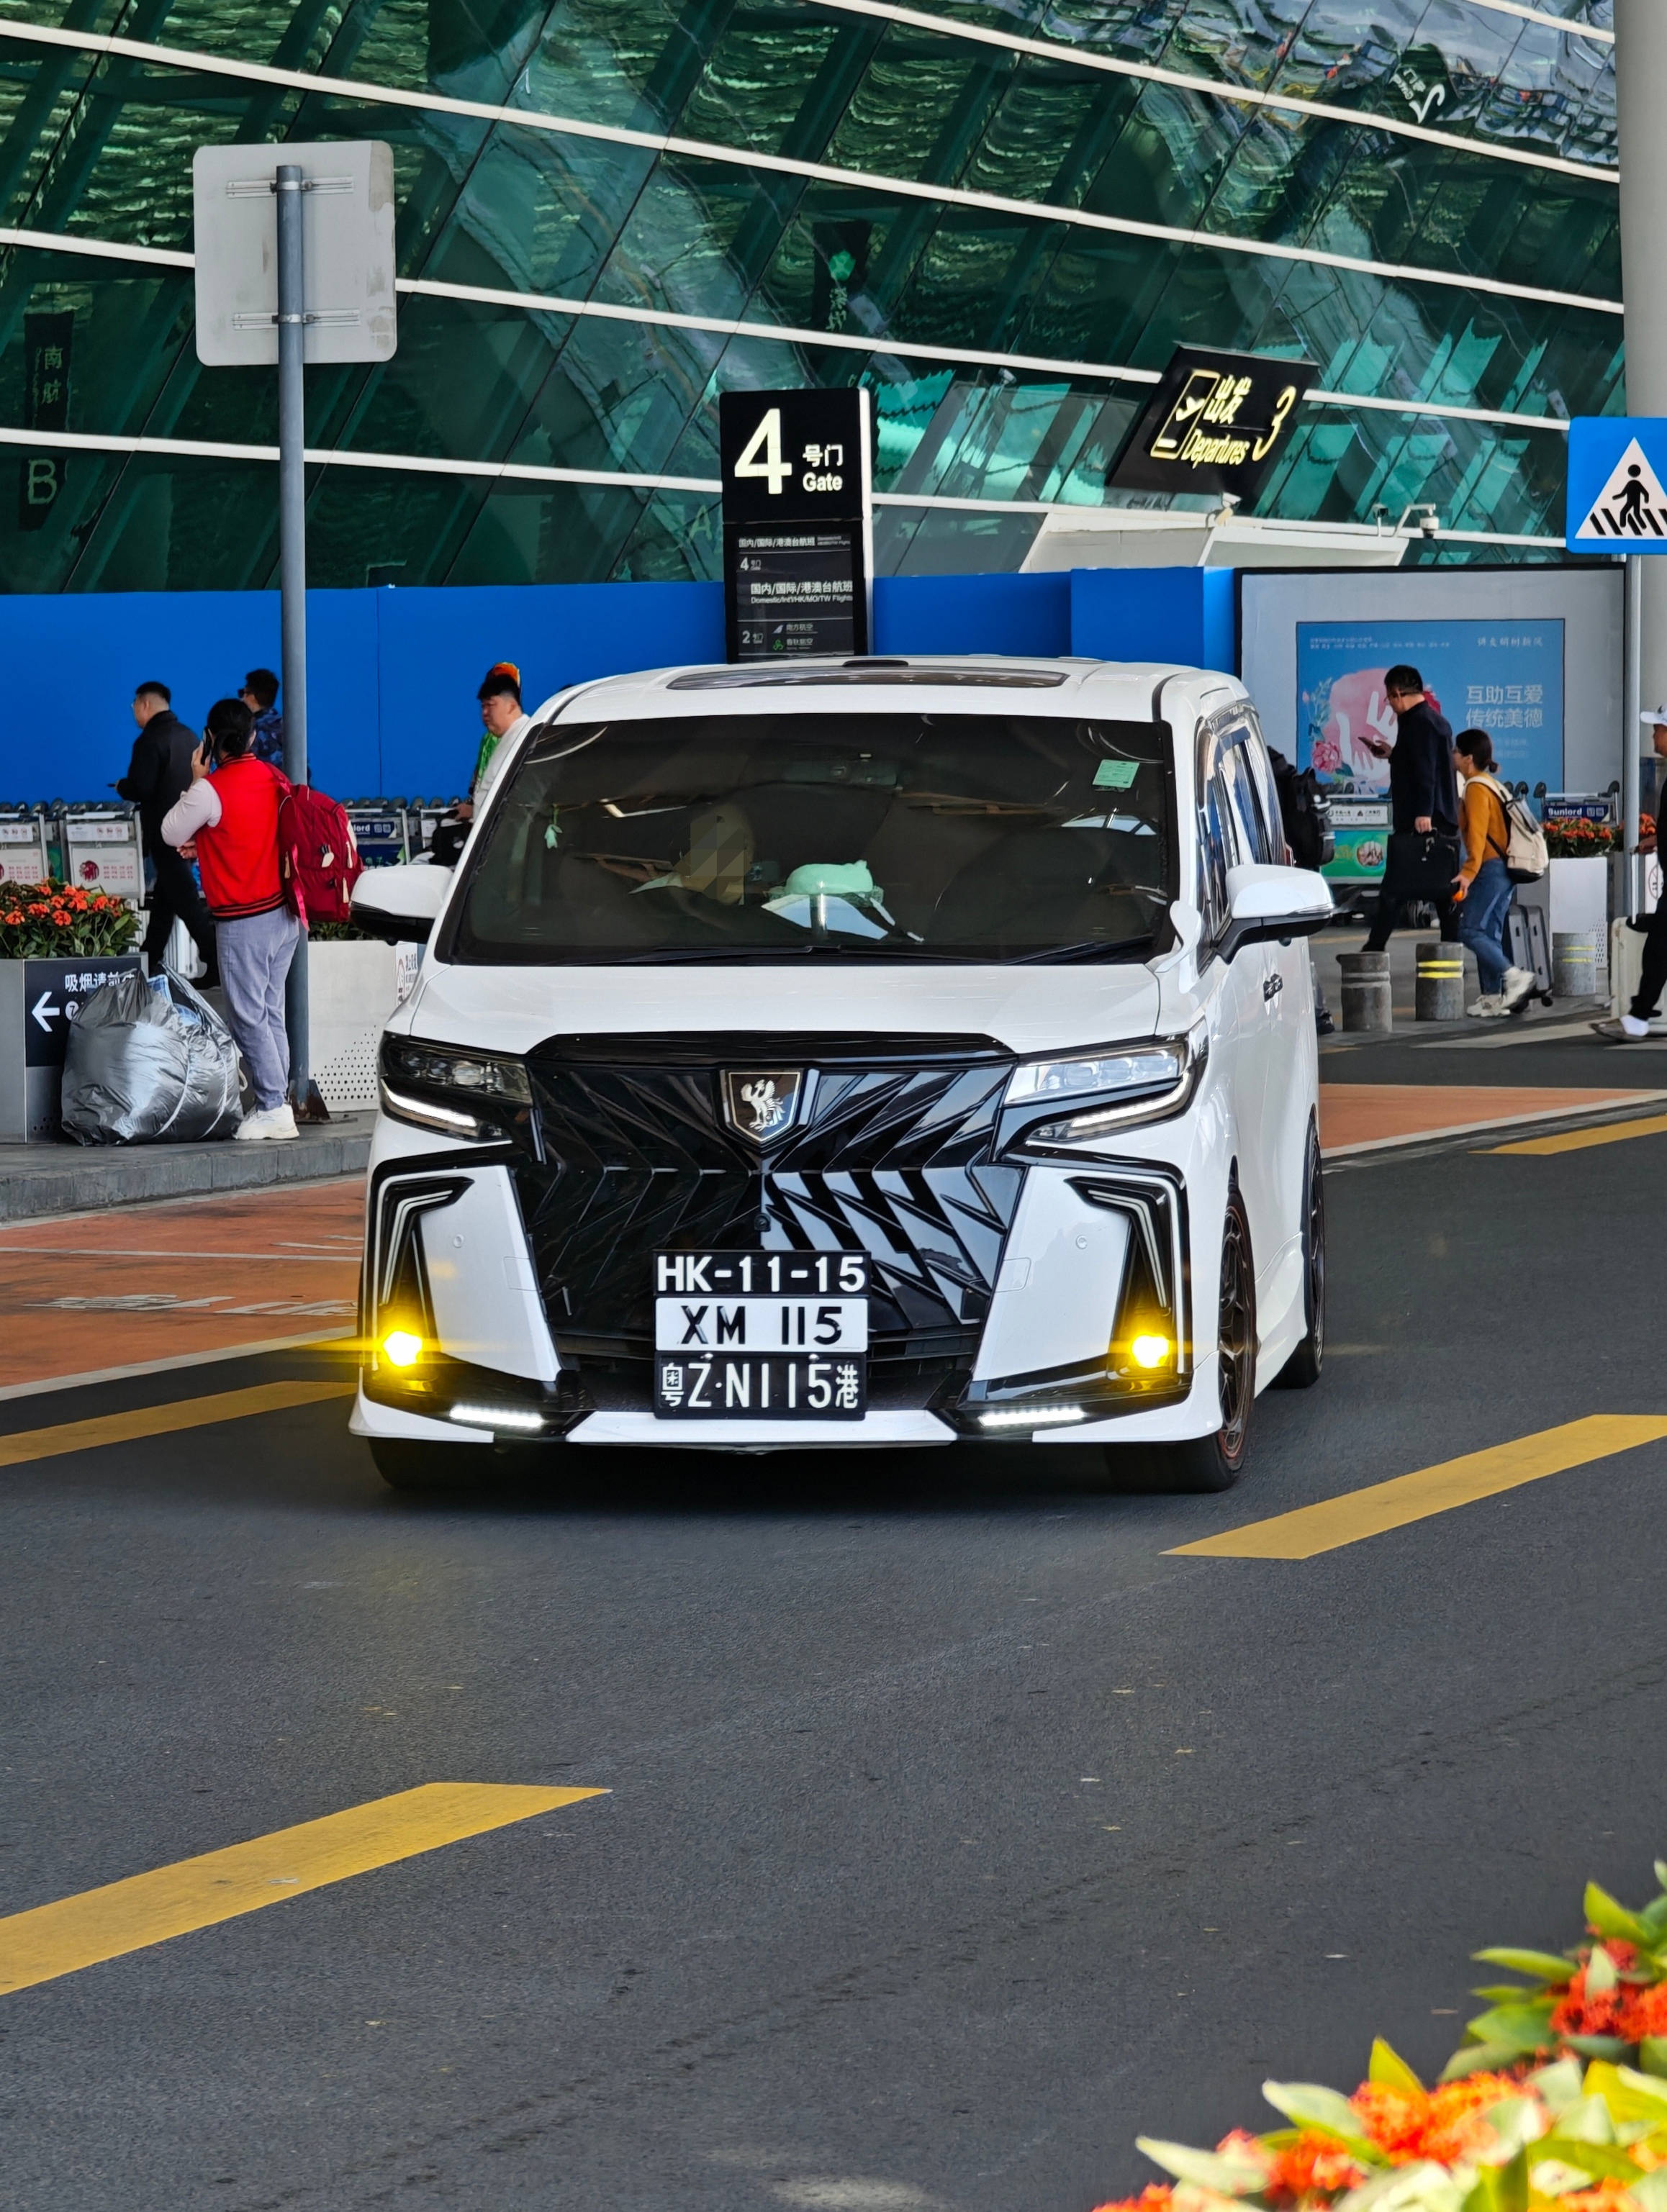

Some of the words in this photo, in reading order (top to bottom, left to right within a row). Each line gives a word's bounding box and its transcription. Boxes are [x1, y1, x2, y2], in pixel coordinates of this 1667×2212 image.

[1252, 386, 1296, 461] 3
[734, 408, 792, 494] 4
[802, 444, 843, 467] 号门
[1180, 428, 1250, 469] Departures
[27, 458, 57, 504] B
[803, 472, 843, 491] Gate
[738, 536, 816, 548] 国内/国际/港澳台航班
[740, 556, 749, 571] 4
[751, 581, 853, 595] 国内/国际/港澳台航班
[742, 630, 750, 644] 2
[1465, 685, 1543, 704] 互助互爱
[1465, 707, 1543, 728] 传统美德
[657, 1256, 866, 1292] HK-11-15
[680, 1305, 746, 1344] XM
[781, 1306, 843, 1345] 115
